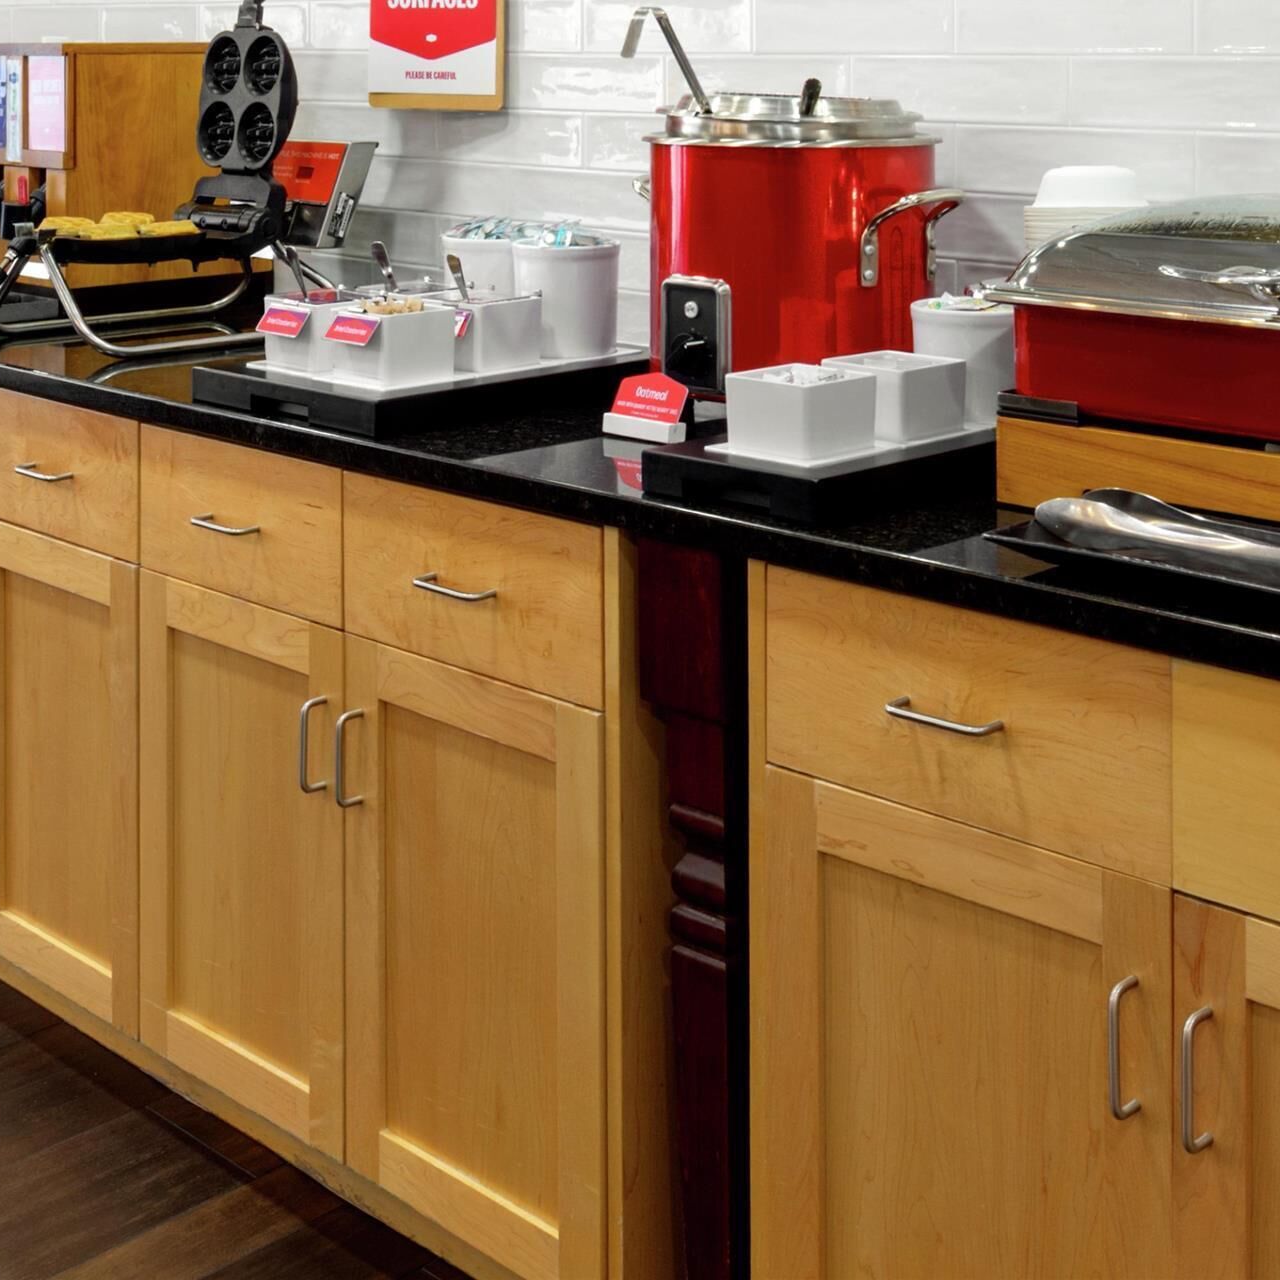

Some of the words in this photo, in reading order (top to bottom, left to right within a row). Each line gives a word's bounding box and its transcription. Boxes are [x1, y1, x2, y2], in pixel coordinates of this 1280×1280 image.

[405, 71, 424, 79] PLEASE
[425, 71, 432, 79] BE
[433, 71, 456, 80] CAREFUL
[635, 386, 669, 401] Oatmeal
